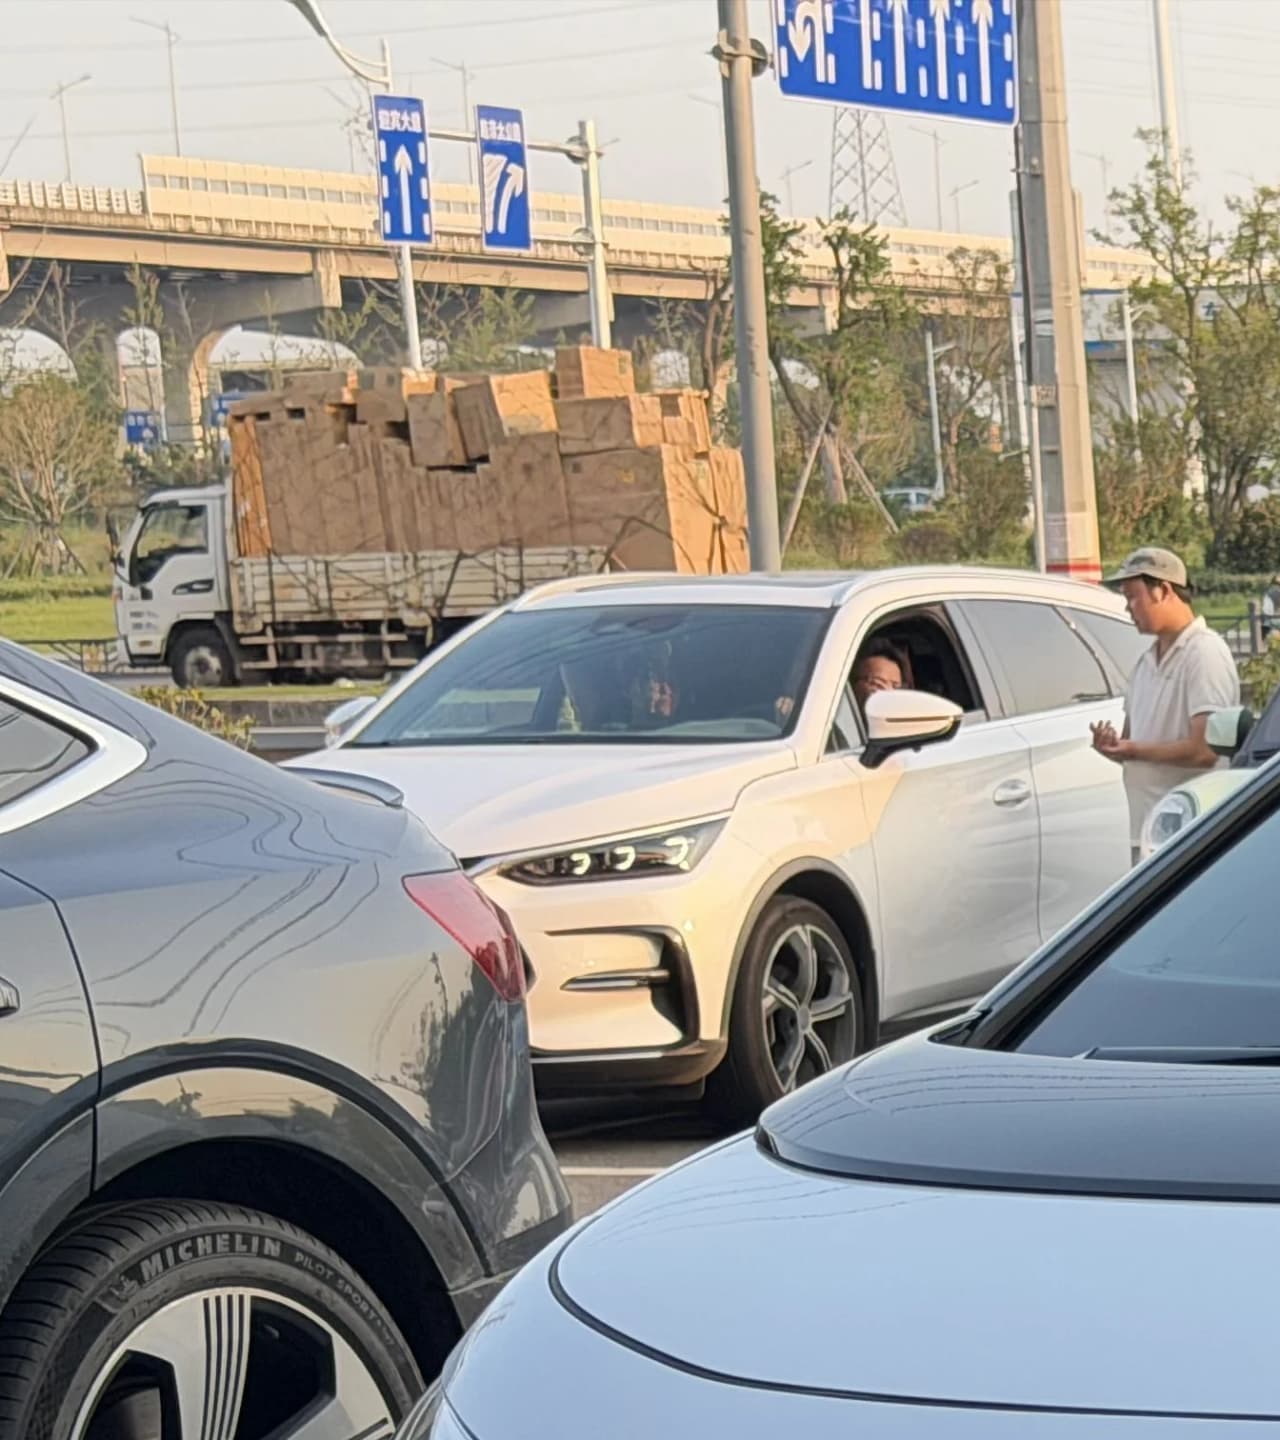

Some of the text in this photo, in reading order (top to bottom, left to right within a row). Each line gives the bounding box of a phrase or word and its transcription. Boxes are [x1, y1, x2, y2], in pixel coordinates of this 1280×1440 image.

[140, 1233, 377, 1321] MICHELIN PILOT SPORT
